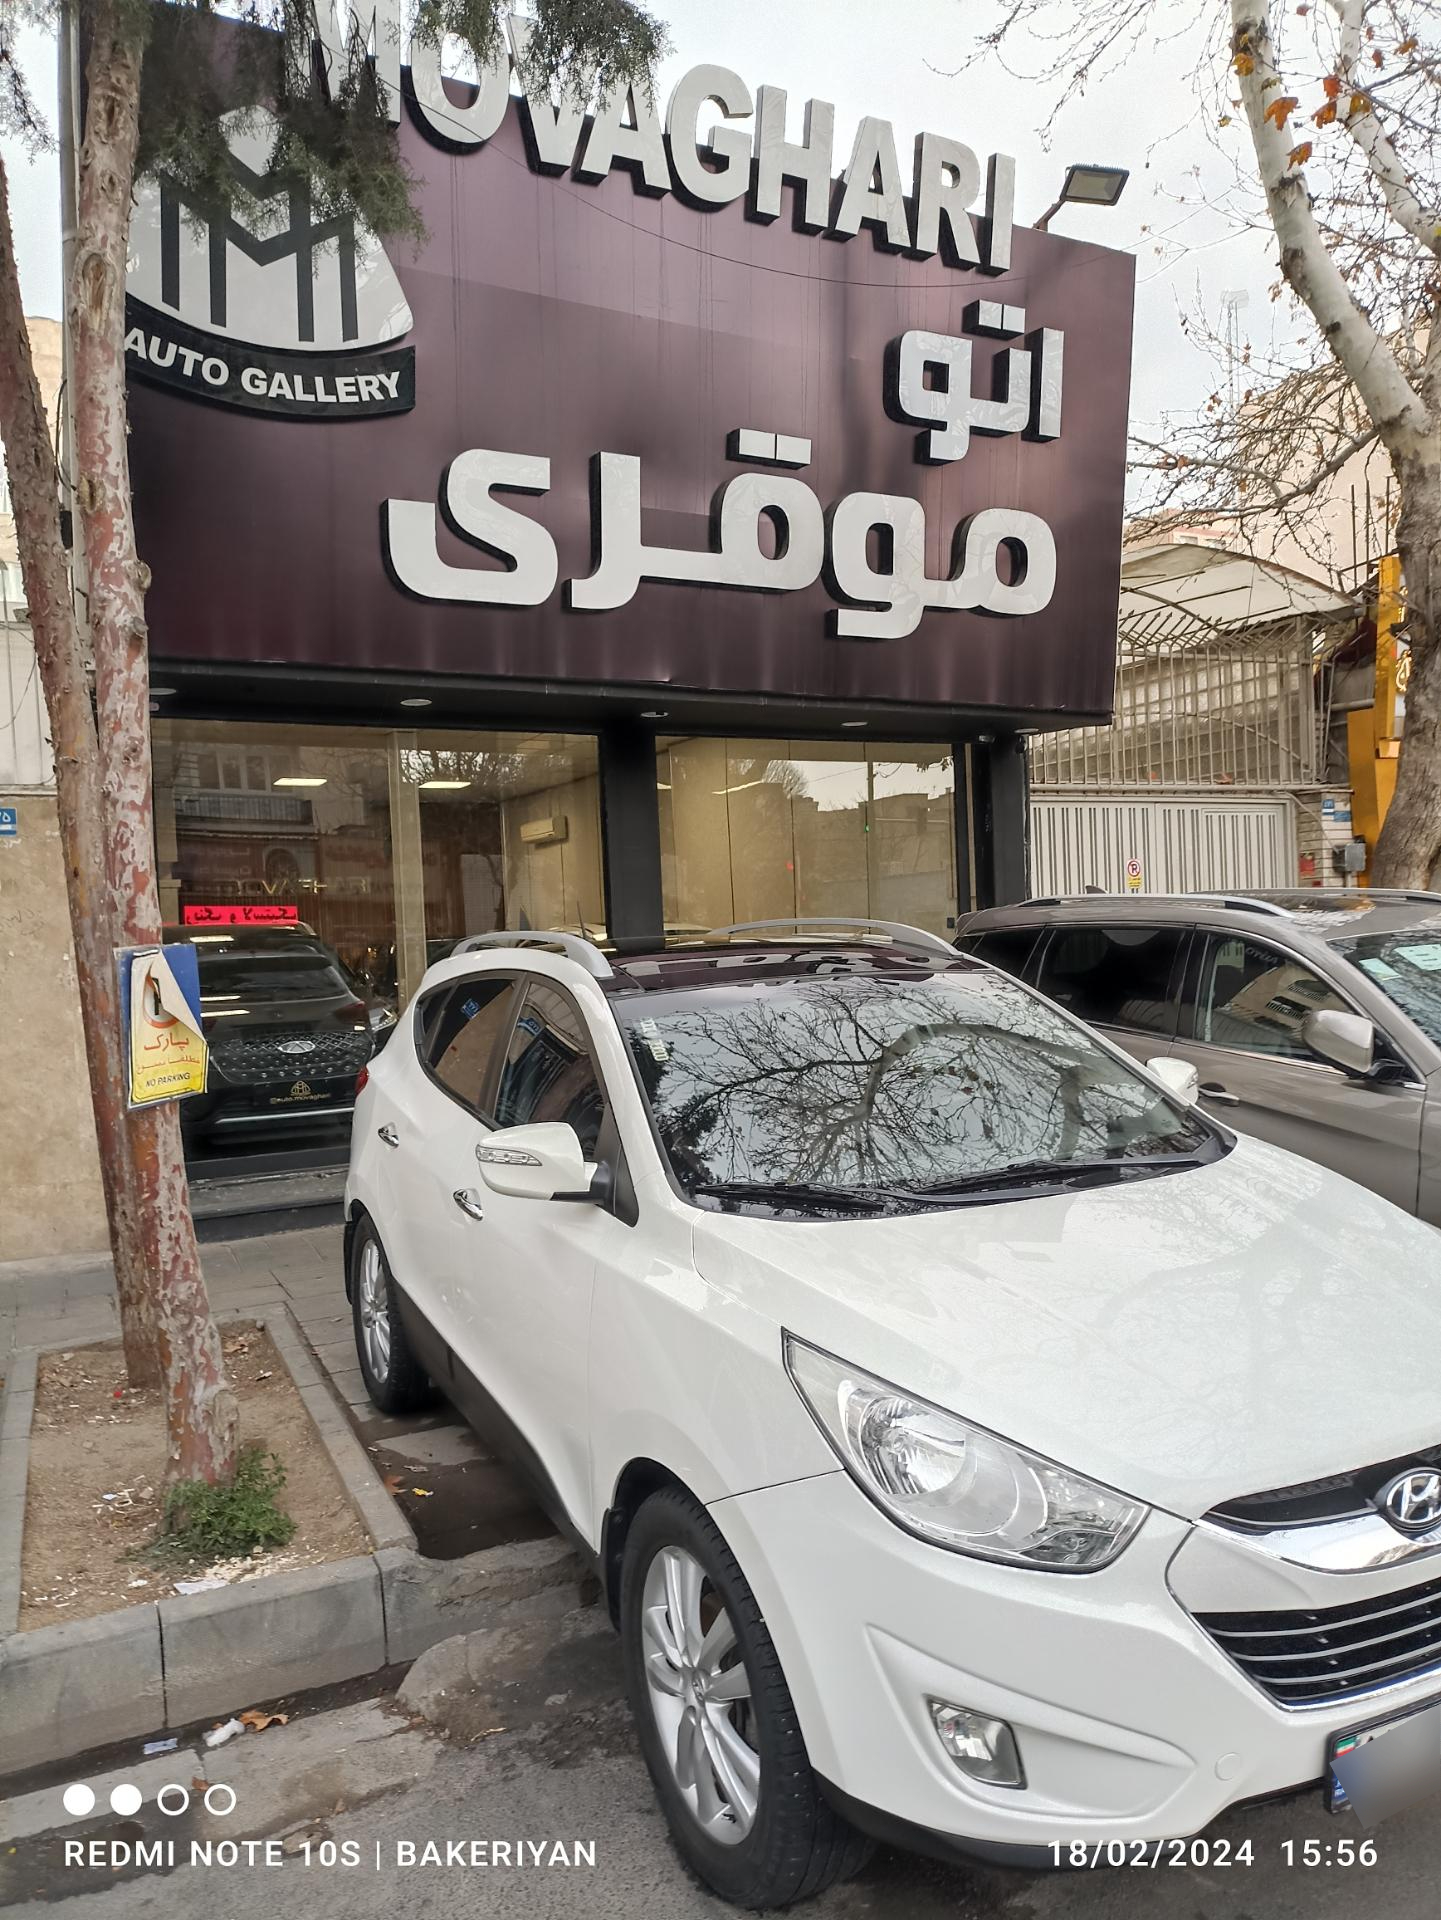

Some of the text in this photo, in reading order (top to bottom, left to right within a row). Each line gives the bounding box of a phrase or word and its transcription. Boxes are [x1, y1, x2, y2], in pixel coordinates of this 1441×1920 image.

[123, 327, 400, 403] AUTO GALLERY
[899, 299, 1065, 460] اتو
[143, 1031, 190, 1052] پارک
[146, 1072, 191, 1087] NO PARKING
